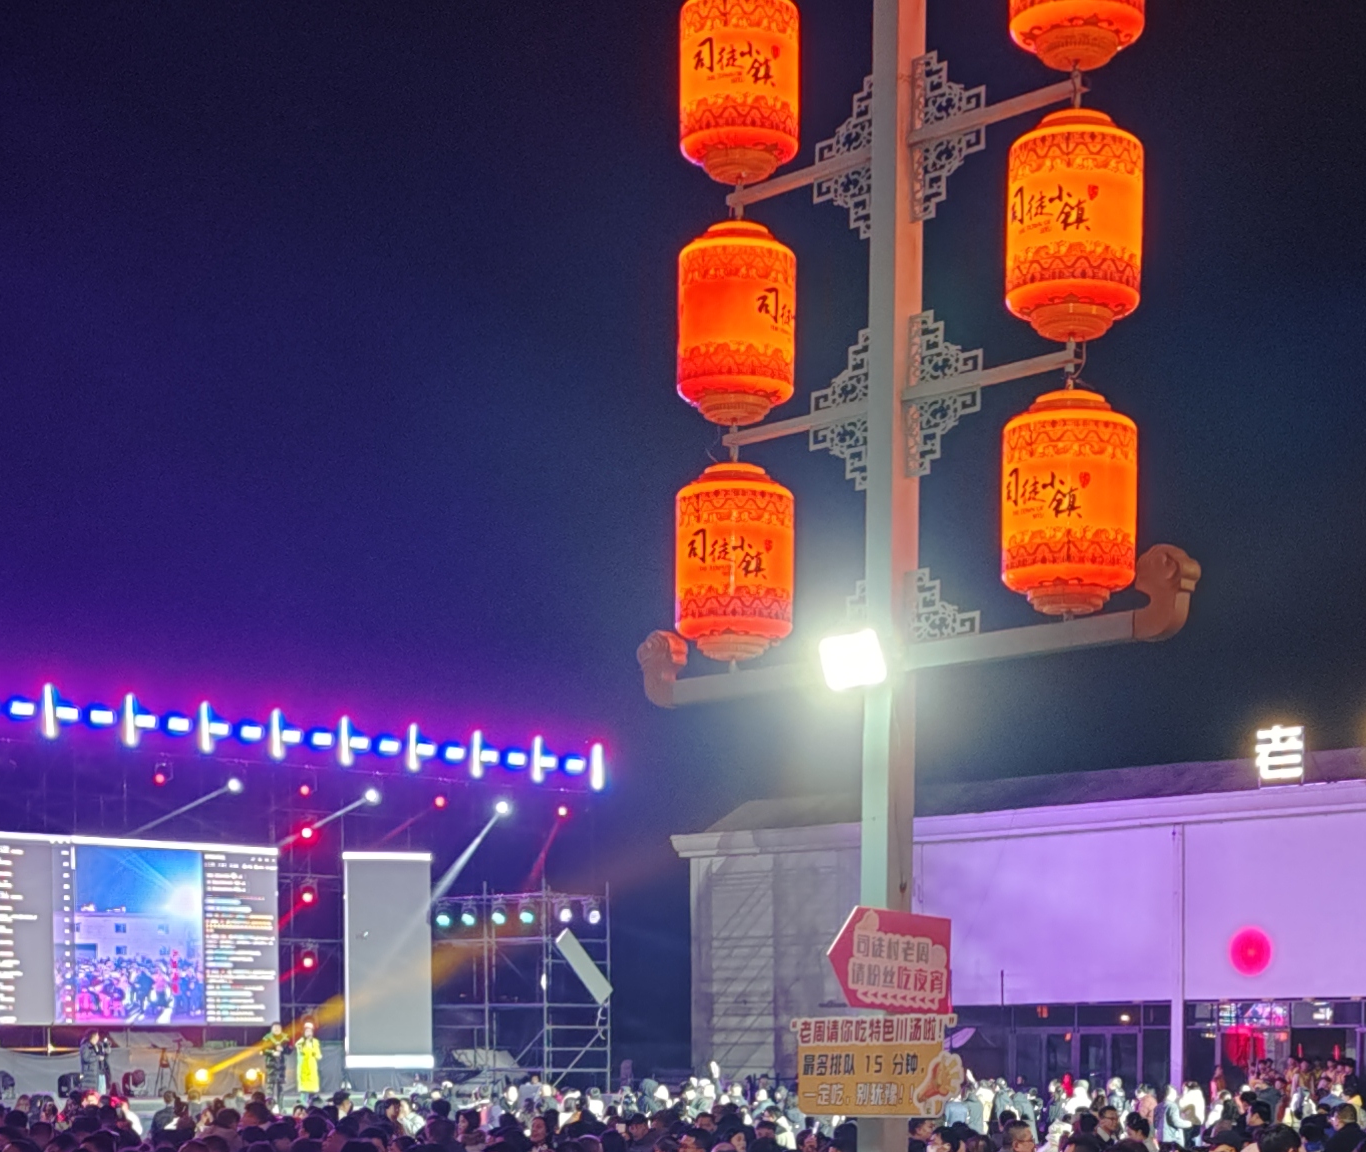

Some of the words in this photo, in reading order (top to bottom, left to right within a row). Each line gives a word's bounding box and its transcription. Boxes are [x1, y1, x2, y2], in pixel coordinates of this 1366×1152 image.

[856, 933, 930, 964] 司徒村老周
[851, 962, 945, 994] 请粉丝吃夜宵
[802, 1053, 856, 1076] 最多排队
[865, 1054, 884, 1074] 15
